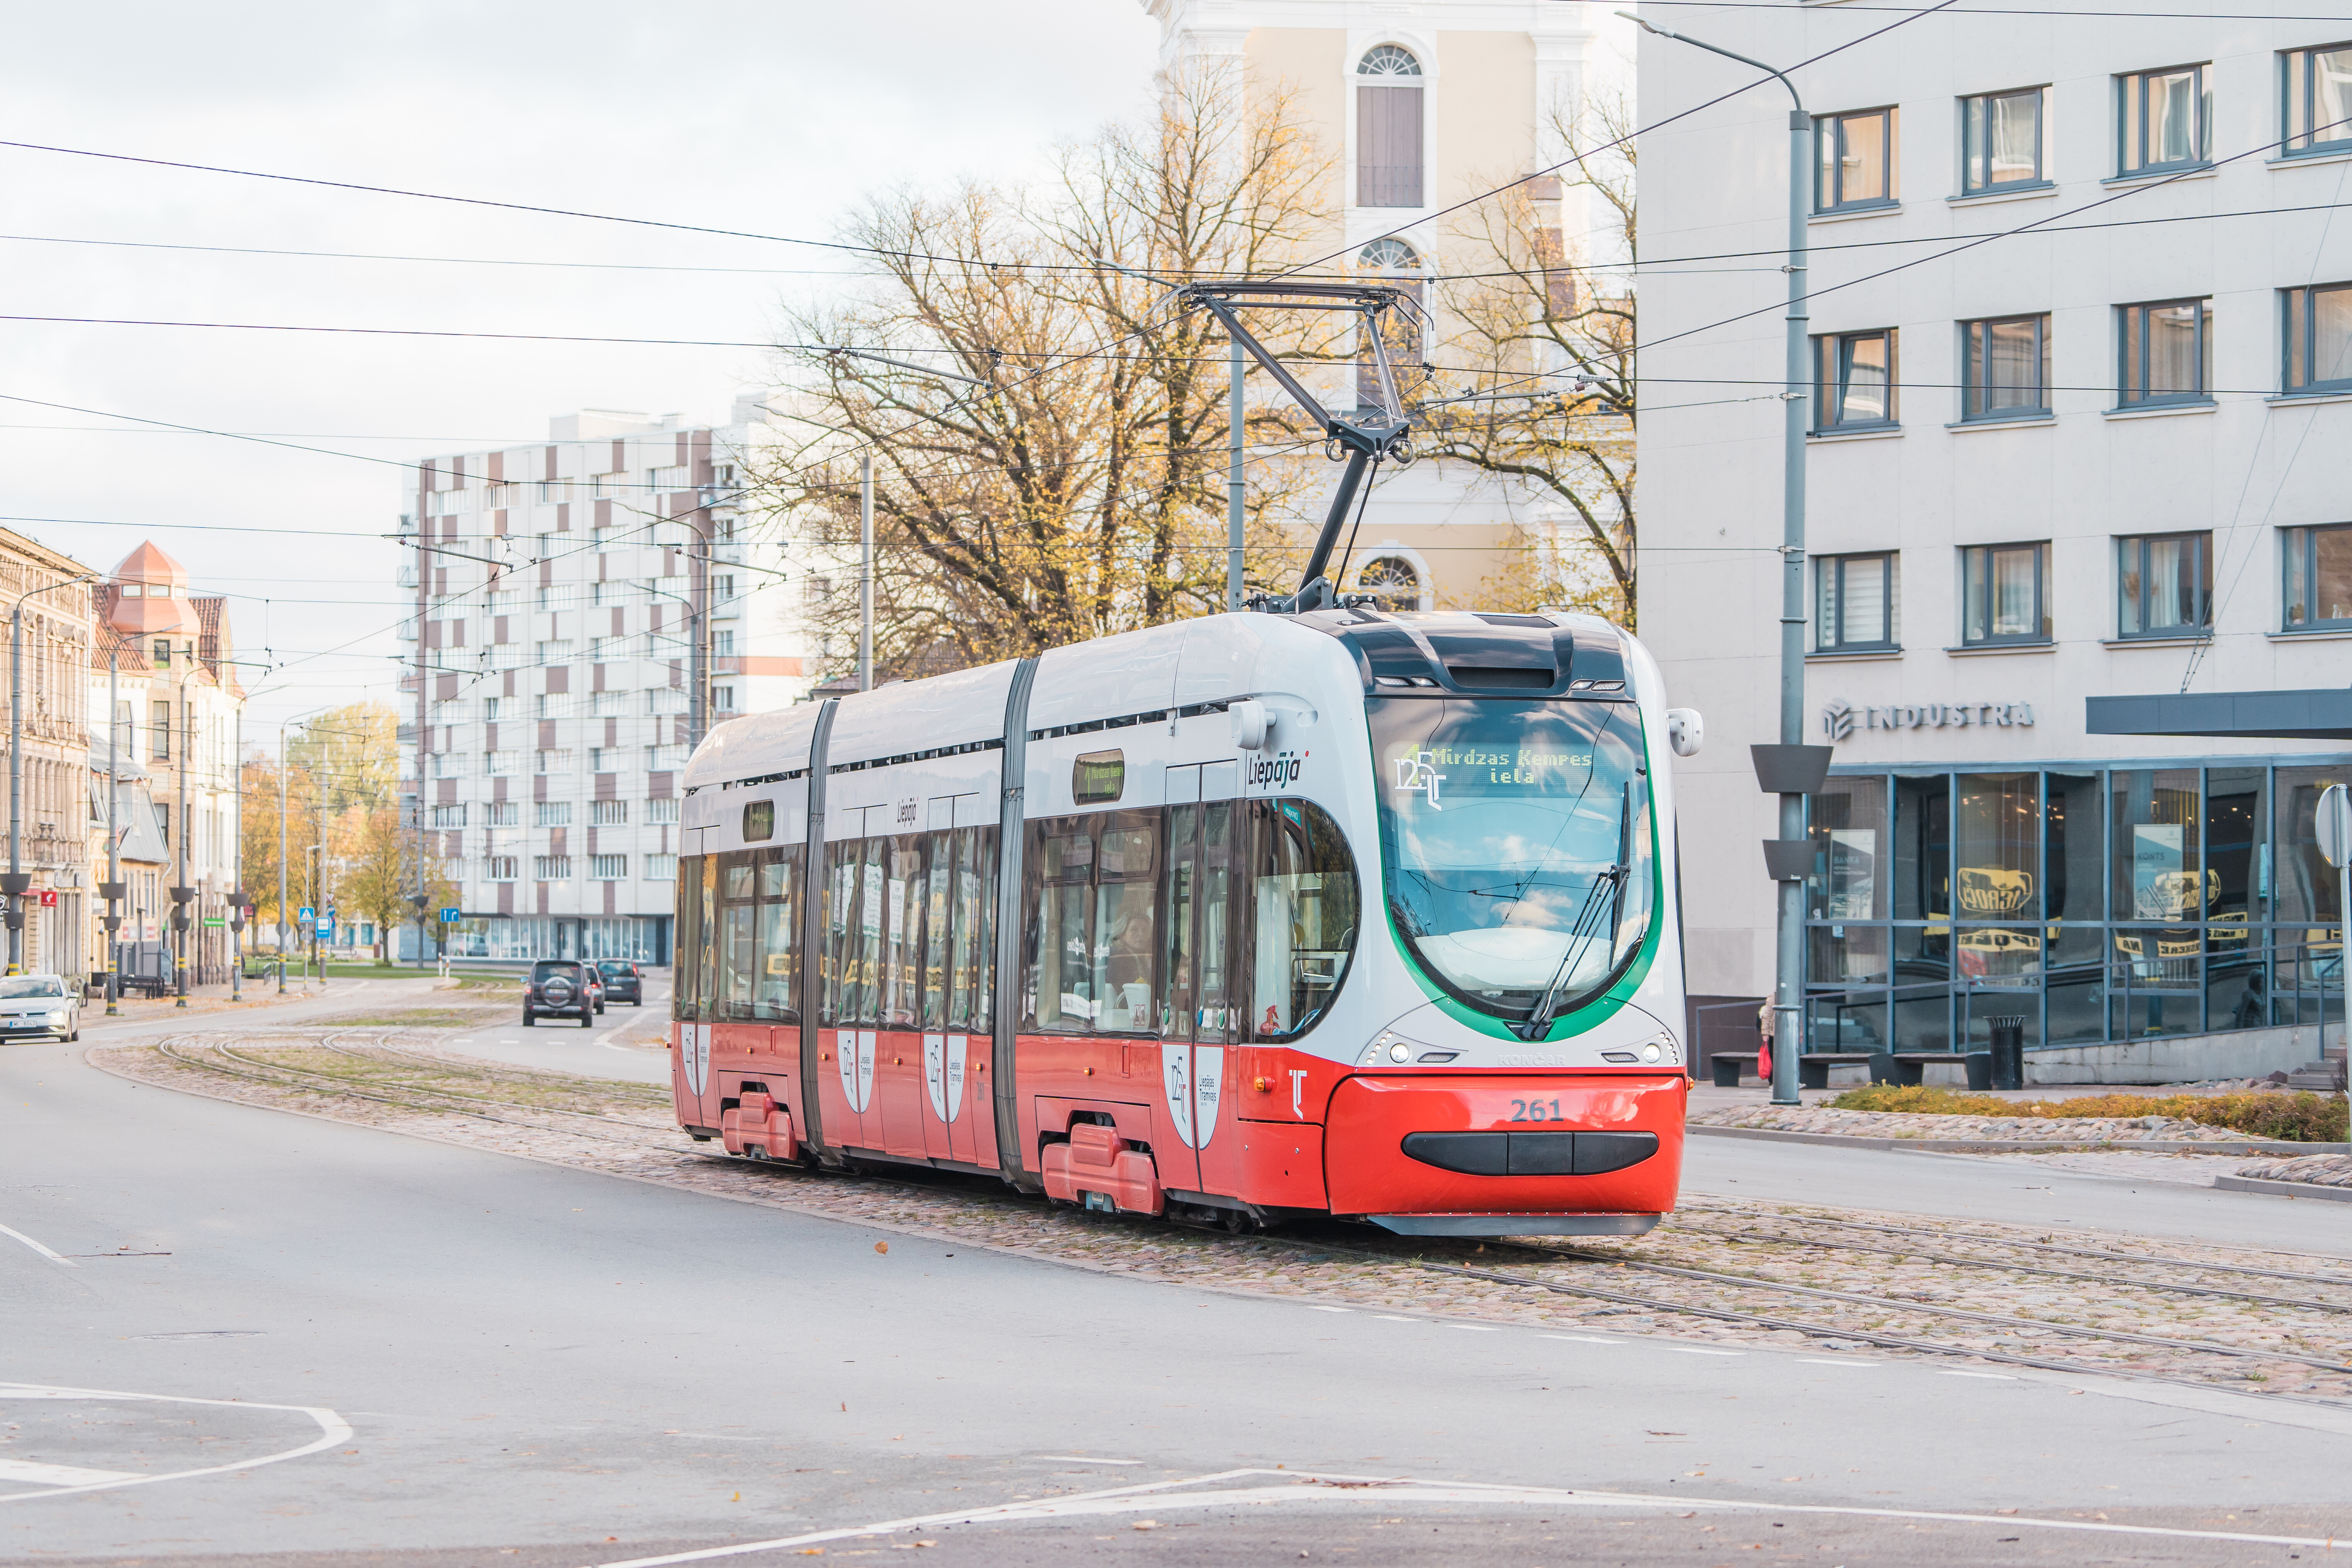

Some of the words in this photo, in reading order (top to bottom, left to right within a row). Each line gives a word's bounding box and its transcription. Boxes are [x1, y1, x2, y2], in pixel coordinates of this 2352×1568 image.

[1864, 701, 2034, 729] INDUSTRA
[1431, 748, 1510, 765] Mirdzas
[1248, 750, 1301, 790] Liepāja
[1491, 768, 1535, 784] iela
[897, 797, 916, 827] Liepāja
[1498, 1052, 1566, 1066] KONČAR
[1199, 1088, 1217, 1105] Tramvajs
[1511, 1098, 1564, 1122] 261
